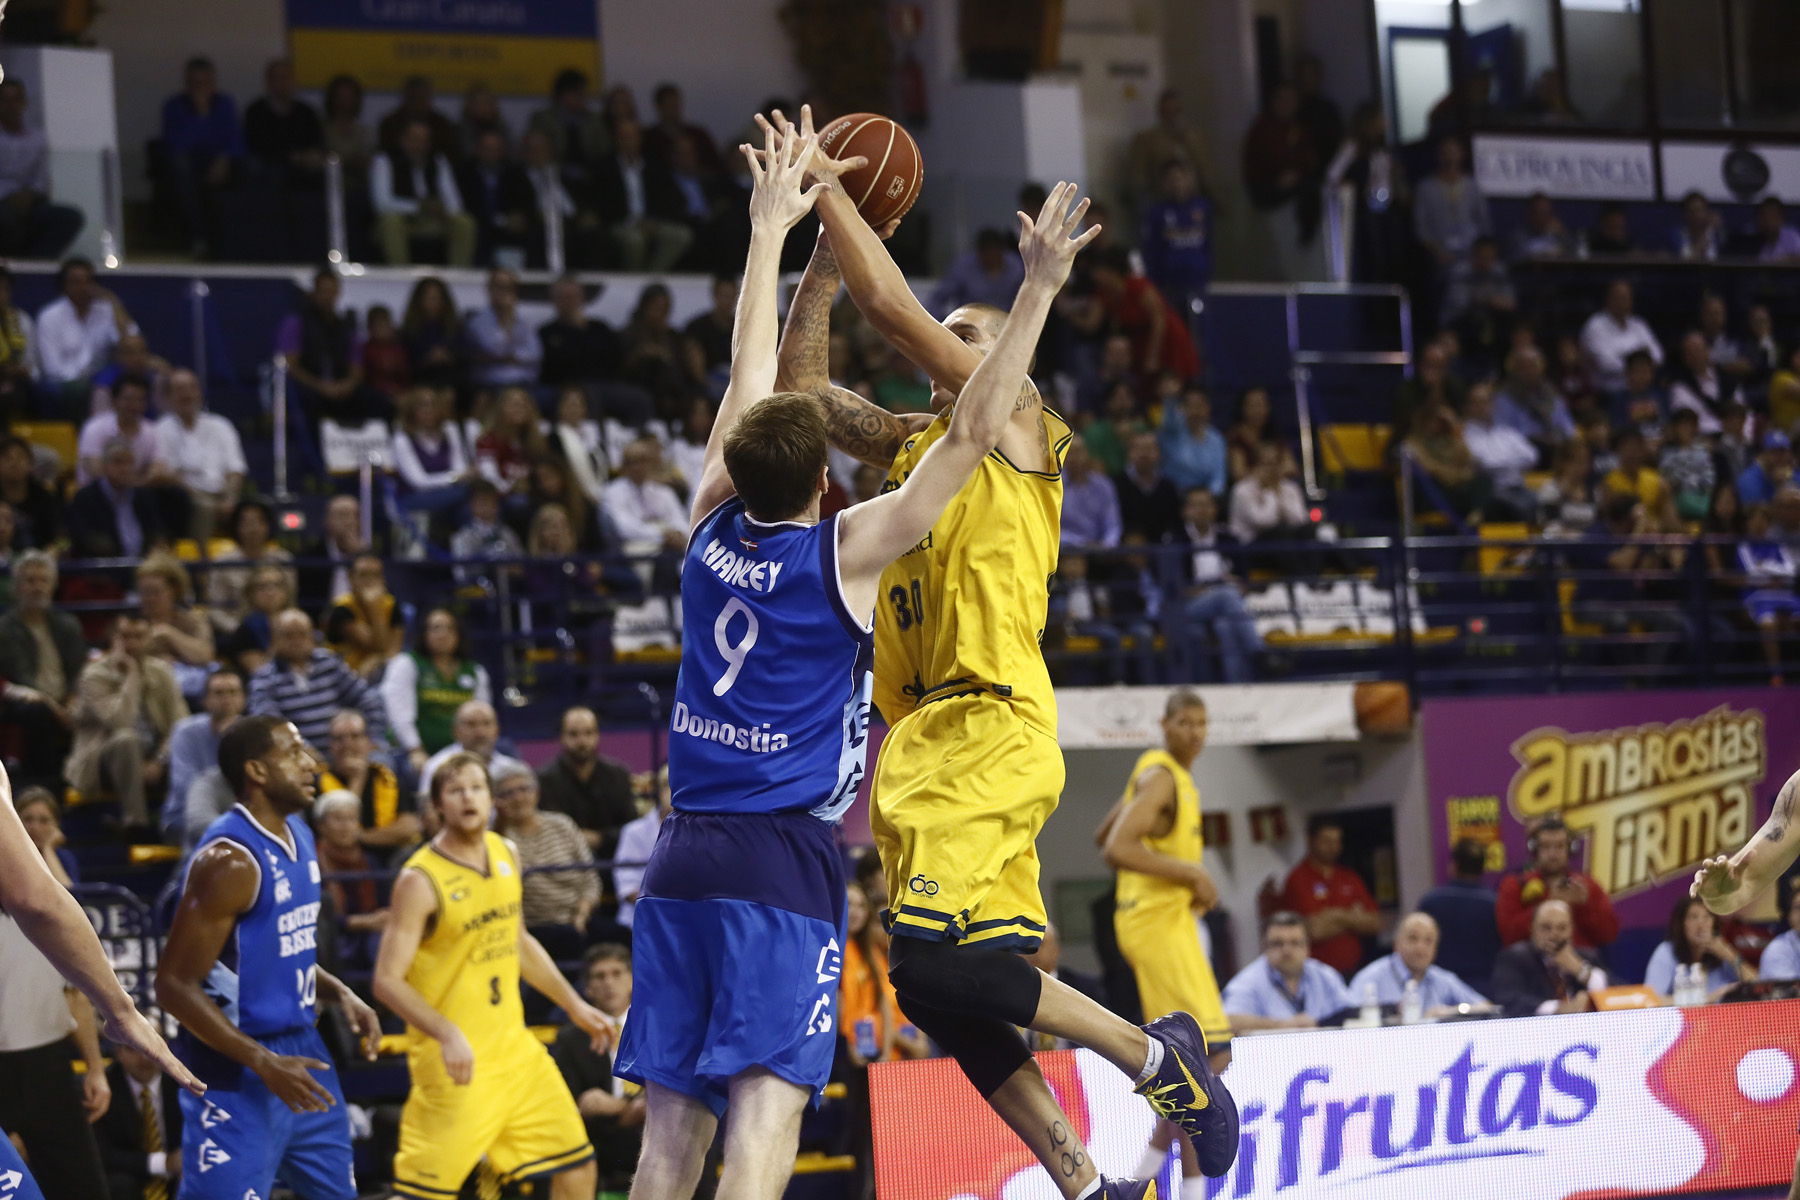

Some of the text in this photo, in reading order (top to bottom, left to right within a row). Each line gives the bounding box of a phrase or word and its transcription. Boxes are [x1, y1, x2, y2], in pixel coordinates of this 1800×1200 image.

[1015, 391, 1038, 412] 2015
[702, 537, 784, 593] HANLEY
[889, 578, 925, 632] 30
[713, 596, 759, 697] 9
[672, 701, 789, 753] Donostia
[1046, 1120, 1068, 1153] 10
[1205, 1040, 1600, 1200] ifrutas
[1061, 1142, 1085, 1178] 06
